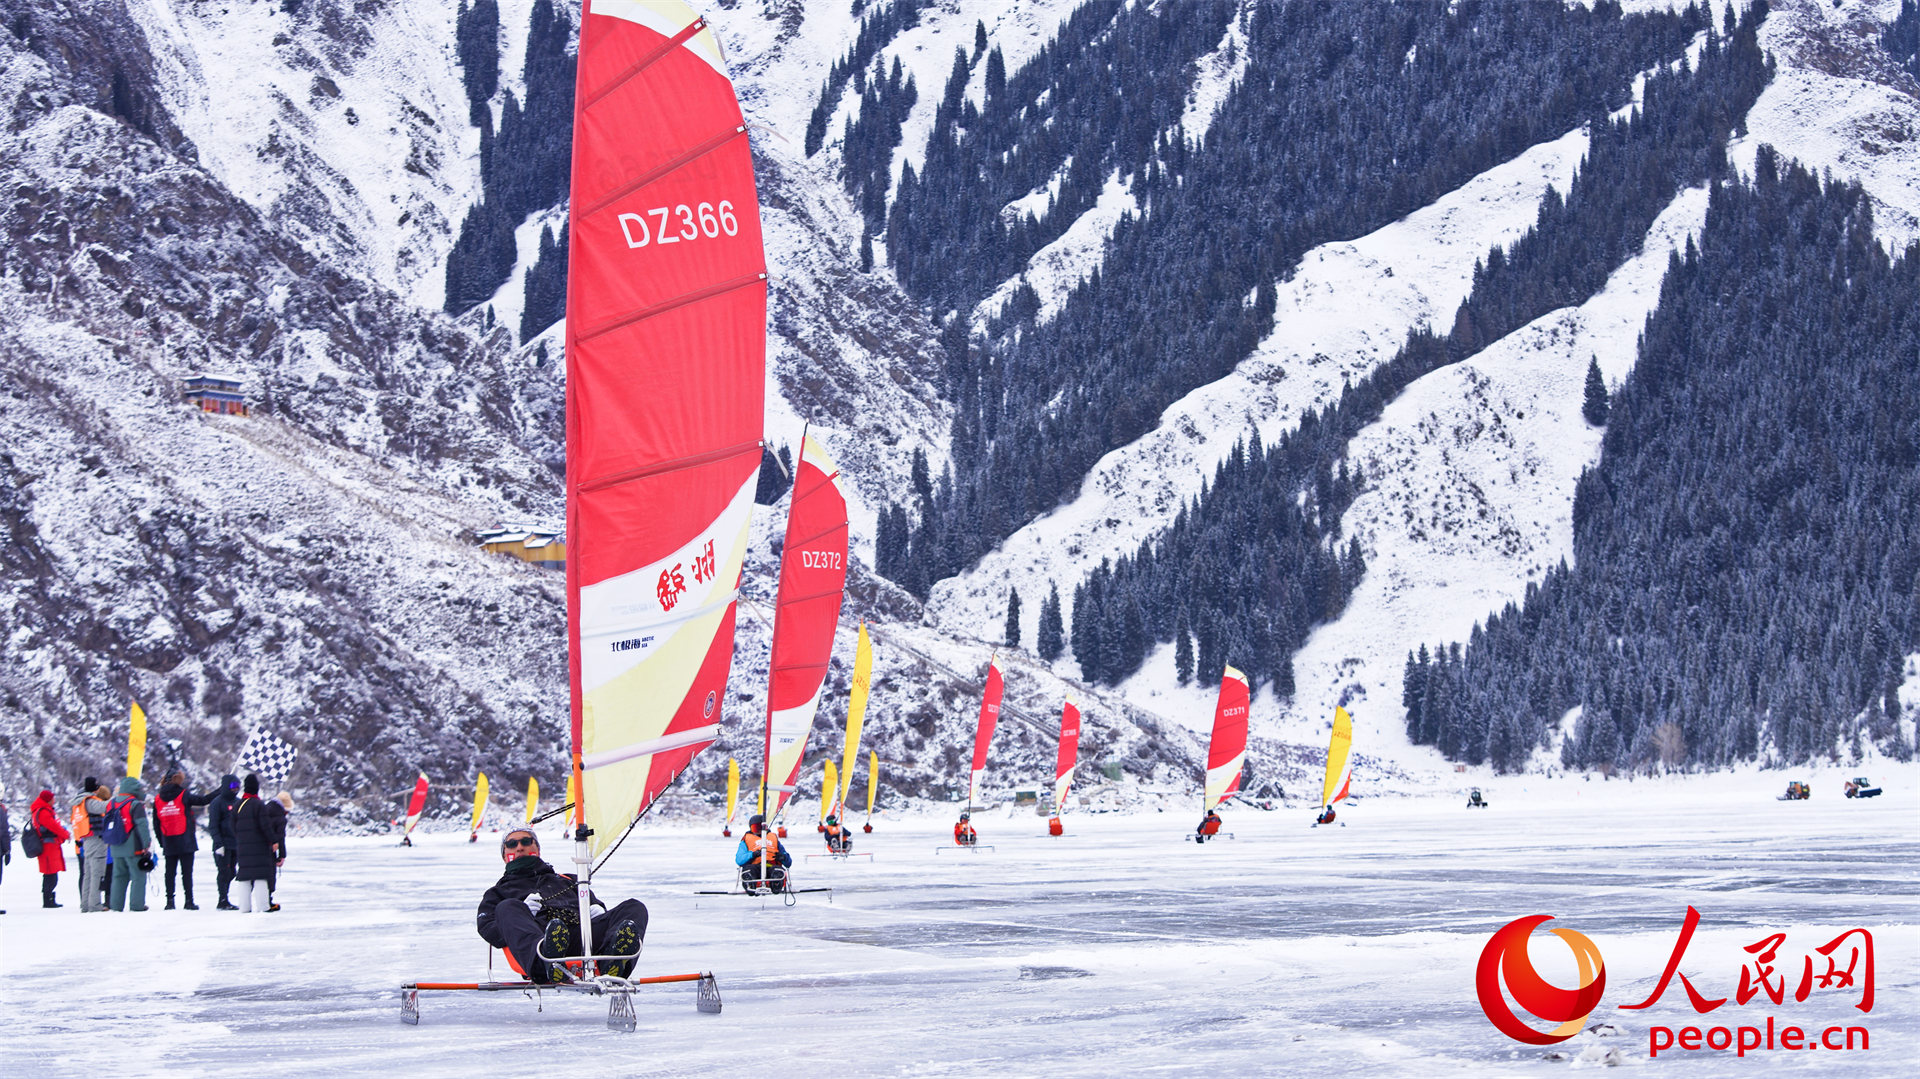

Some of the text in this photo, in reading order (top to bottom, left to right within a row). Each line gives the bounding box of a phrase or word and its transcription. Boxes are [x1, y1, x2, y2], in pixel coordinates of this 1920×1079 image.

[617, 199, 738, 249] DZ366
[802, 550, 841, 570] DZ372
[1223, 706, 1245, 717] DZ371
[579, 889, 589, 898] 01
